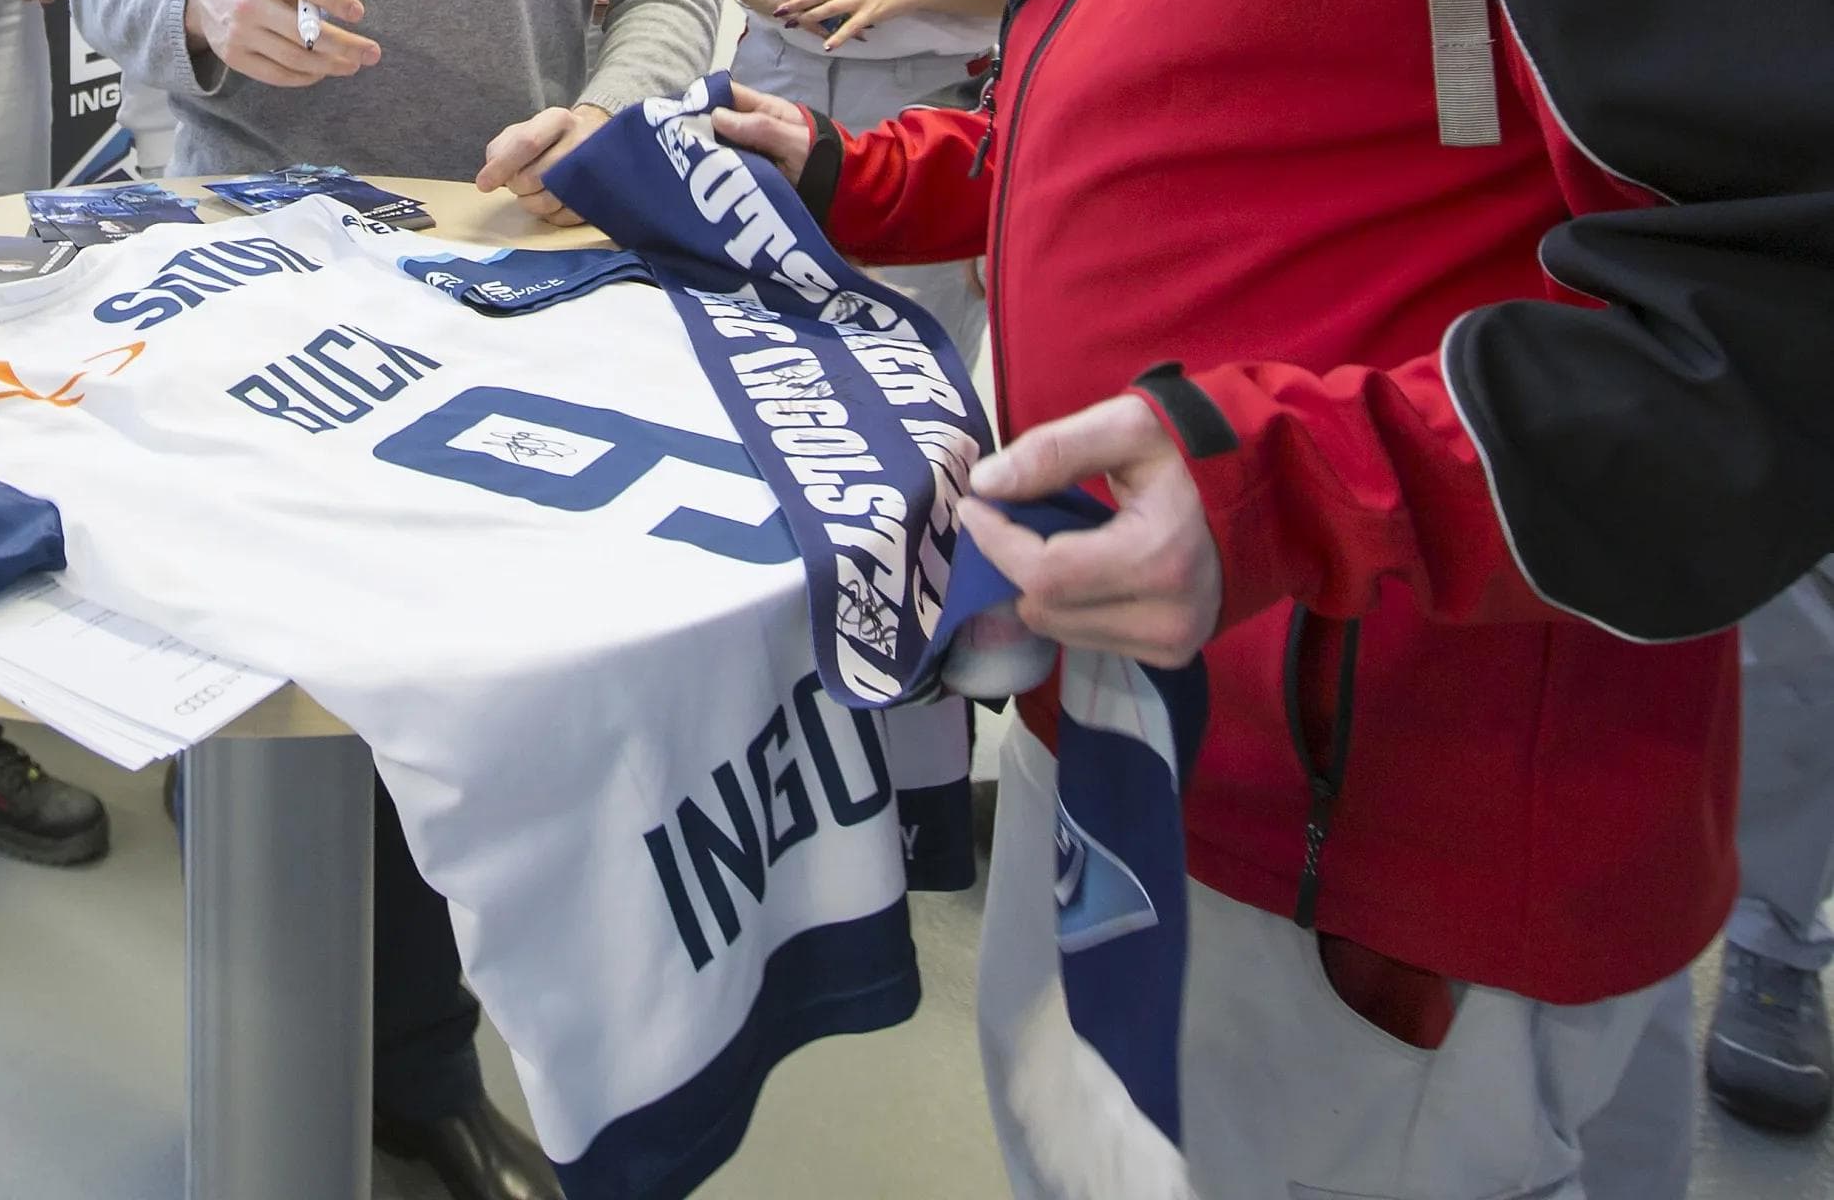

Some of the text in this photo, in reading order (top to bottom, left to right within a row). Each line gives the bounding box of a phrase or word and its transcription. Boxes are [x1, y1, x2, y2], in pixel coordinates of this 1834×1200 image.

[93, 237, 324, 331] SATUR
[225, 324, 443, 434] BUCK
[372, 385, 804, 566] 9
